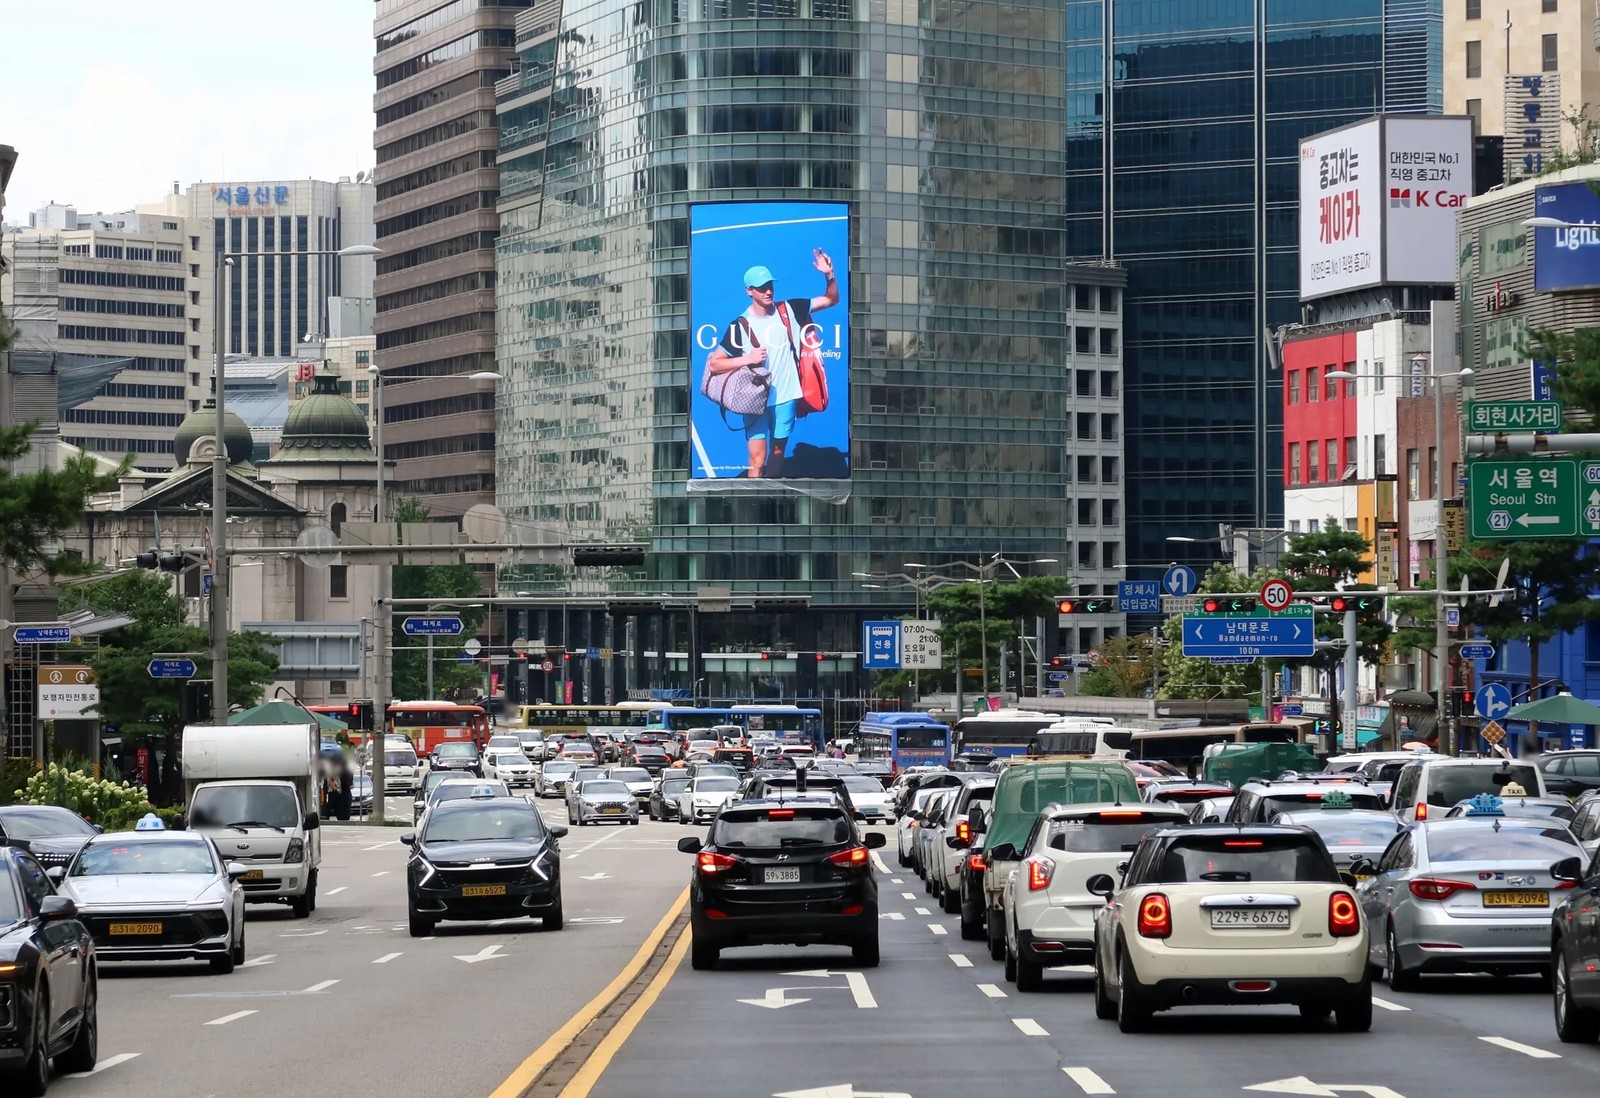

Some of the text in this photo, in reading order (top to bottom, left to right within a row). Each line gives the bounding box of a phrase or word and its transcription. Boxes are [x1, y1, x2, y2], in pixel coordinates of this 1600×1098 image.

[1390, 152, 1459, 165] 대한민국 No.1
[1319, 147, 1359, 190] 중고차는
[1390, 168, 1451, 181] 직영 중고차
[215, 185, 289, 207] 서울신문
[1416, 190, 1467, 207] K Car
[1319, 188, 1360, 245] 케이카
[696, 323, 841, 350] GUCCI
[1475, 406, 1557, 426] 회현사거리
[1489, 467, 1558, 489] 서울역
[1490, 492, 1556, 505] Seoul Stn
[1494, 515, 1507, 527] 21
[1123, 584, 1155, 596] 정체시
[1268, 587, 1286, 604] 50
[1120, 598, 1158, 610] 진입금지
[1226, 622, 1270, 634] 남대문로
[919, 635, 939, 643] 21:00
[1219, 634, 1278, 642] Namdaemun-ro
[874, 640, 892, 649] 전용
[905, 644, 926, 652] 토요일
[905, 654, 926, 664] 공휴일
[43, 693, 96, 701] 보행자안전통로
[1252, 911, 1285, 923] 6676
